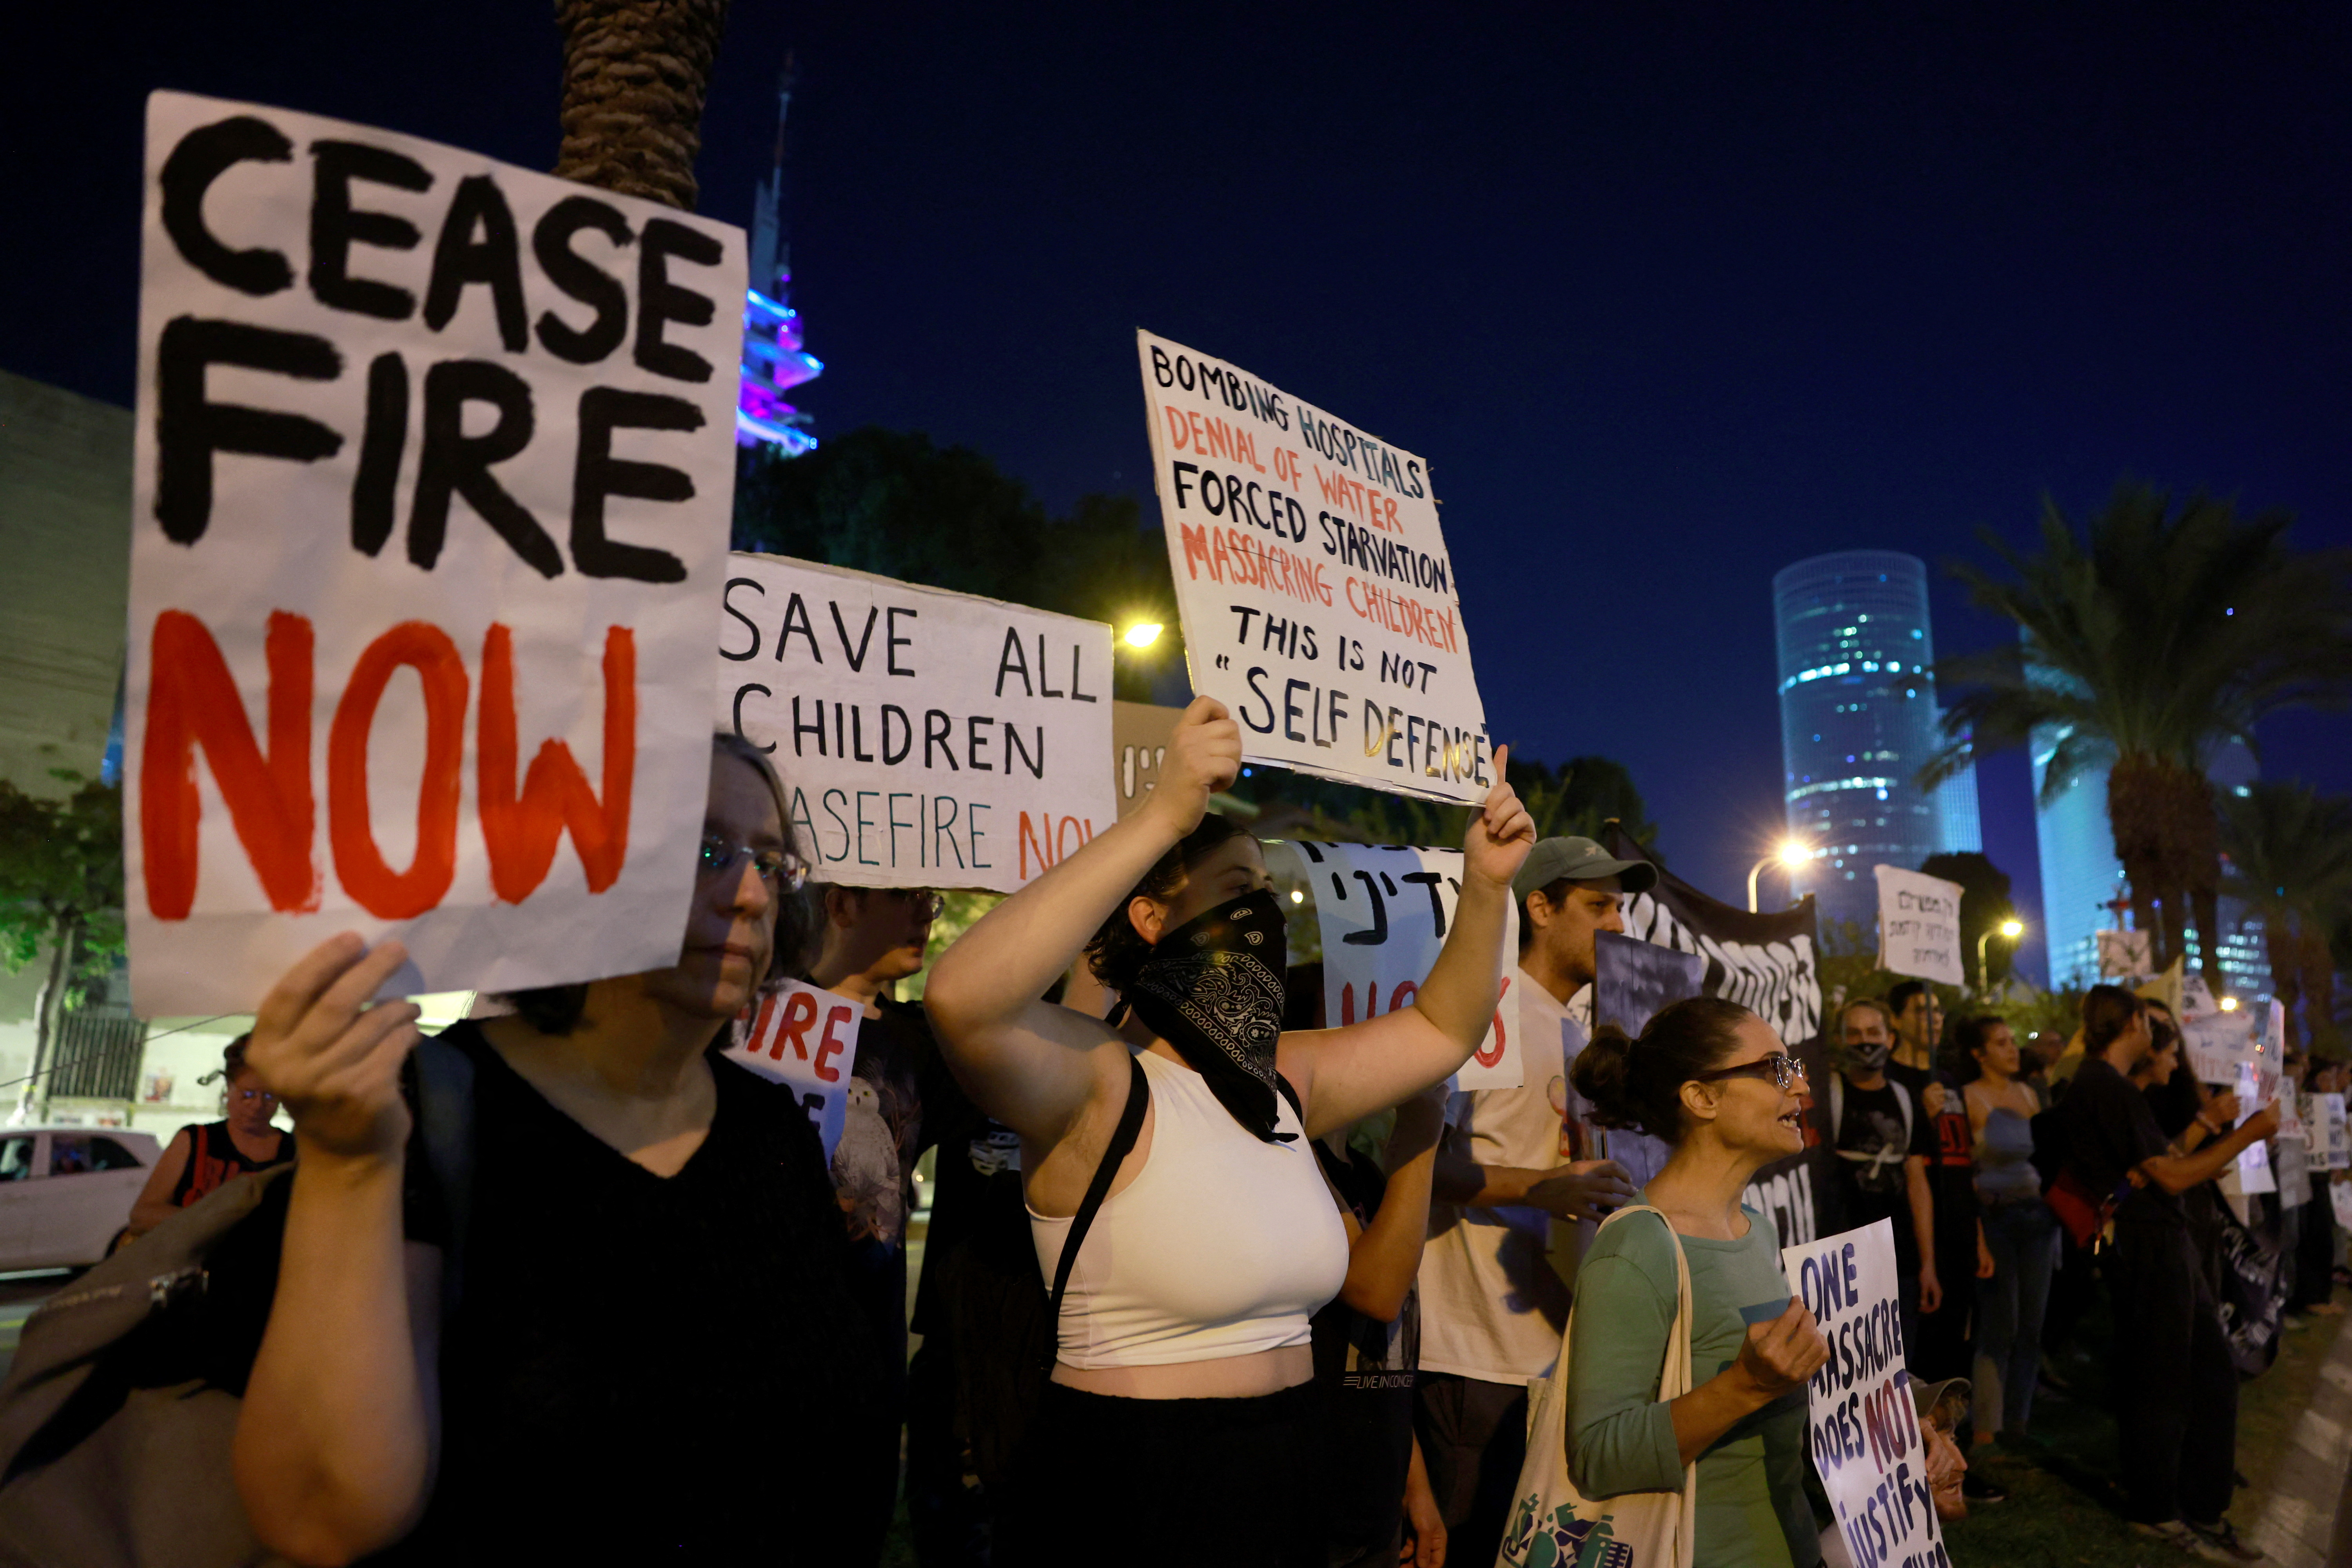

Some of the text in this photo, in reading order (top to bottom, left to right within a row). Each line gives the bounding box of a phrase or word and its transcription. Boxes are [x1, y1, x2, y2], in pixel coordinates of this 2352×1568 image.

[160, 115, 724, 383] CEASE
[153, 314, 707, 584] FIRE
[1151, 345, 1425, 499] BOMBING HOSPITALS
[1164, 405, 1404, 535] DENIAL OF WATER
[1173, 460, 1449, 594] FORCED STARVATION
[719, 577, 1097, 703] SAVE ALL
[1180, 522, 1458, 654] MASSACRING CHILDREN
[1230, 605, 1437, 695] THIS IS NOT
[140, 607, 639, 921] NOW
[733, 682, 1044, 779] CHILDREN
[790, 786, 991, 869] ASEFIRE
[1331, 870, 1461, 946] דיני
[737, 992, 852, 1083] IRE
[1801, 1243, 1858, 1326] ONE
[1357, 1376, 1379, 1388] LIVE
[1379, 1376, 1390, 1388] IN
[1814, 1368, 1918, 1481] DOES NOT
